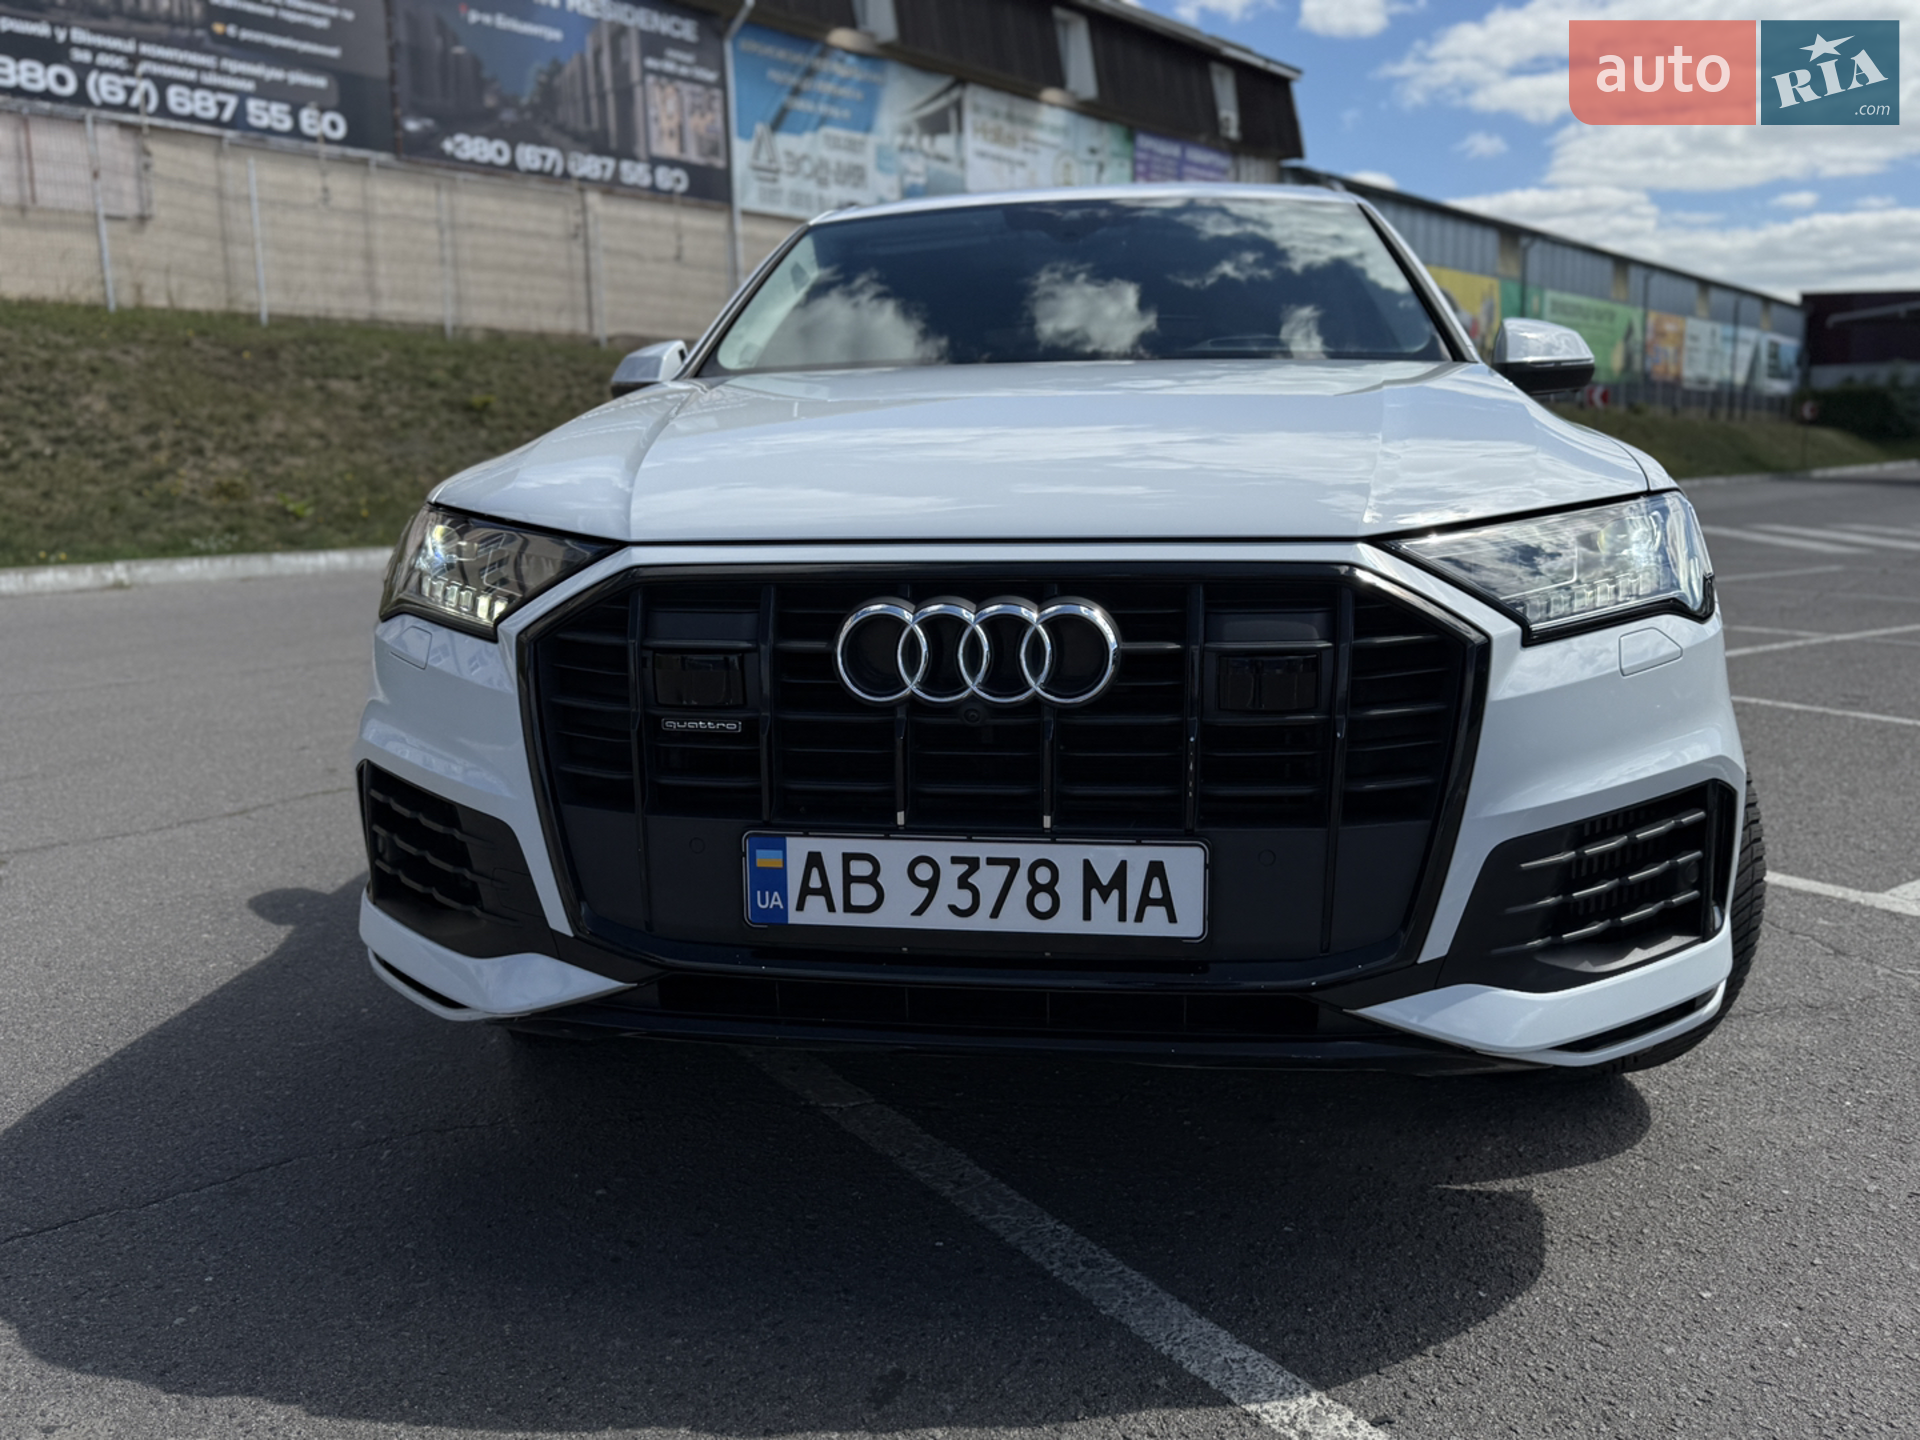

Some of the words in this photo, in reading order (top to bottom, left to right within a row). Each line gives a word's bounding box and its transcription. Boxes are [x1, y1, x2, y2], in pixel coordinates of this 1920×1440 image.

[86, 69, 159, 113] (67)
[166, 84, 239, 122] 687
[246, 97, 294, 132] 55
[298, 106, 347, 141] 60
[441, 133, 512, 167] +380
[515, 142, 564, 178] (67)
[619, 159, 653, 187] 55
[654, 165, 689, 193] 60
[664, 720, 737, 729] quattro
[756, 890, 784, 910] UA
[795, 851, 885, 914] AB
[907, 855, 1061, 921] 9378
[1082, 858, 1178, 924] MA
